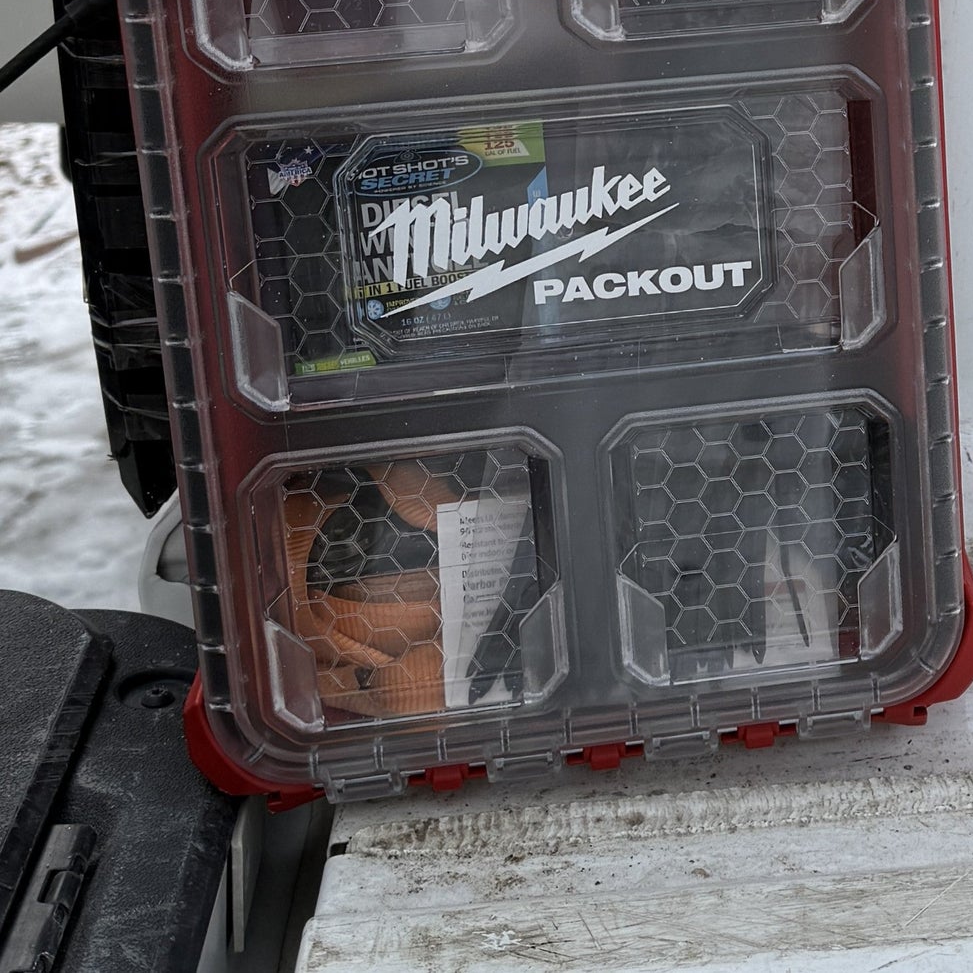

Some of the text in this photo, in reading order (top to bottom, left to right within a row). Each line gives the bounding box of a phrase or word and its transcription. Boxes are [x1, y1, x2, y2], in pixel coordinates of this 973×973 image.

[360, 167, 456, 190] SECRET
[393, 155, 469, 175] SHOT'S
[369, 165, 671, 287] Milwaukee
[533, 260, 752, 305] PACKOUT
